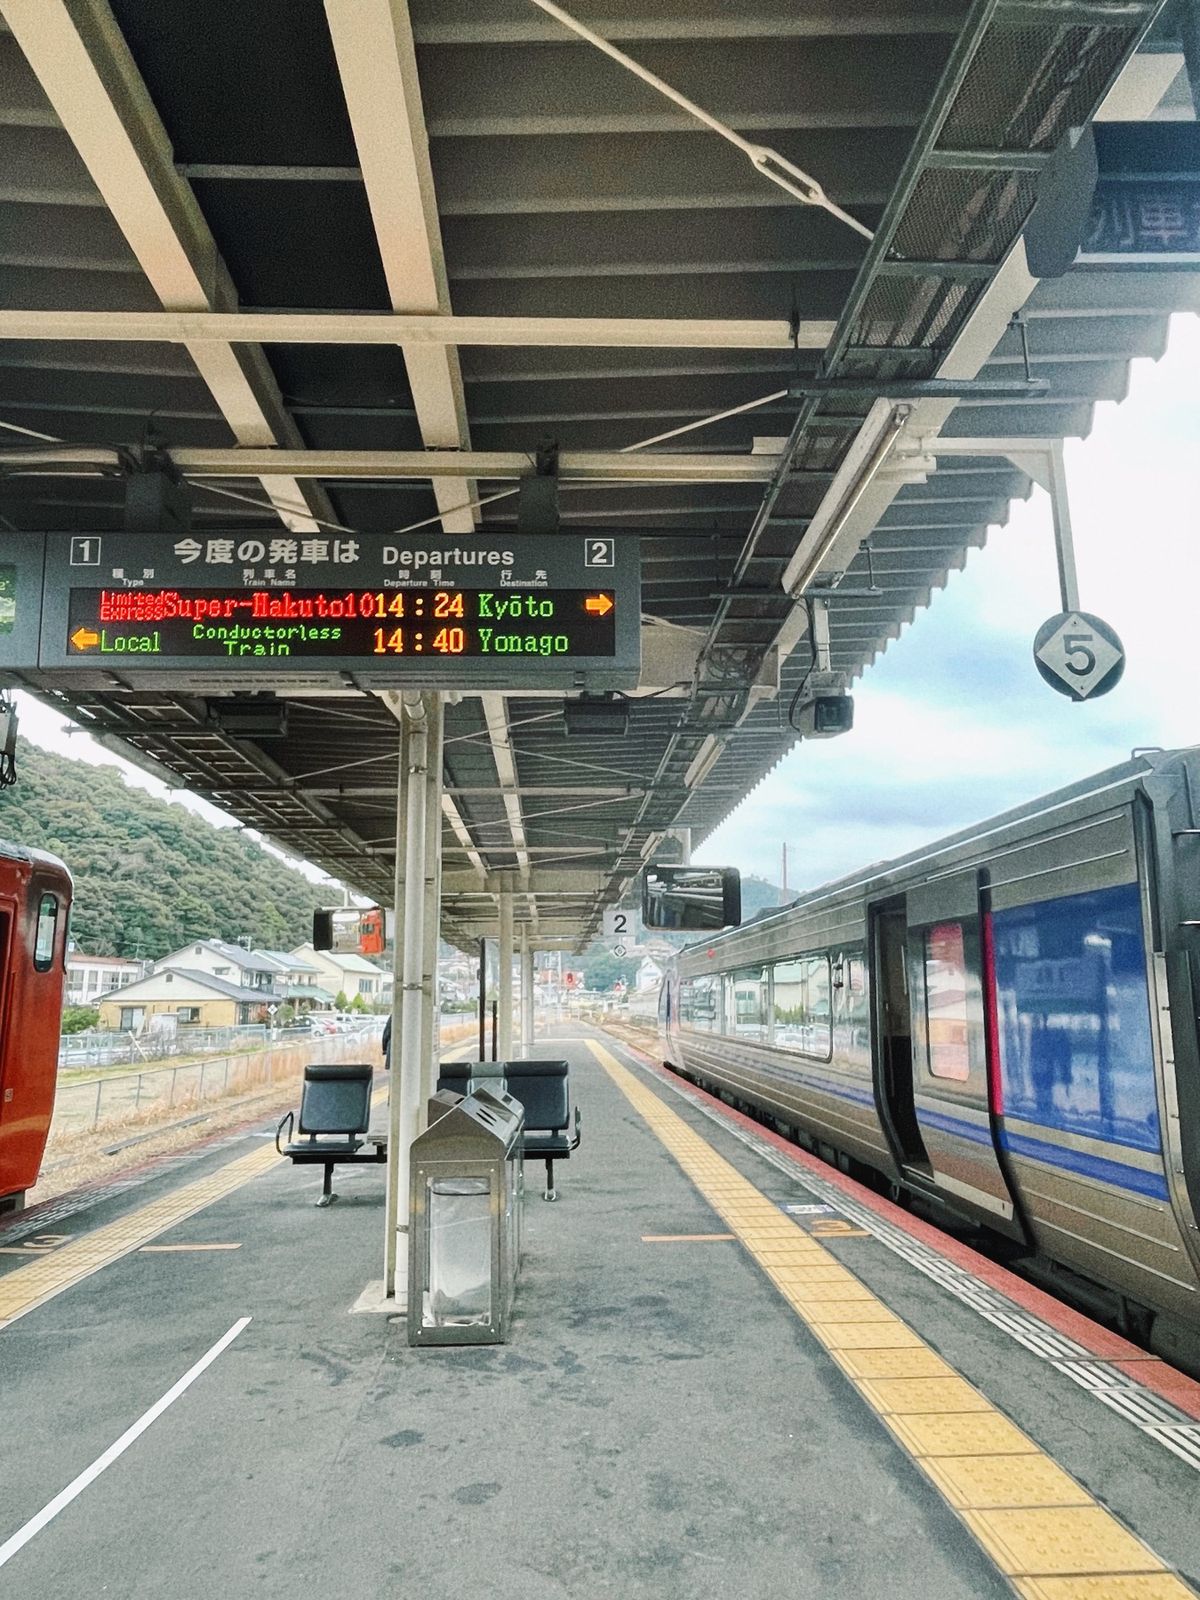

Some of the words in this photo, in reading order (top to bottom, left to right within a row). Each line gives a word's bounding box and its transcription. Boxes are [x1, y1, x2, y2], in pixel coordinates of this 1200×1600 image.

[79, 540, 91, 562] 1
[173, 538, 360, 565] 今度の発車は
[382, 547, 515, 569] Departures
[591, 542, 608, 564] 2
[121, 578, 144, 588] Type
[243, 578, 266, 586] Train
[270, 578, 297, 586] Name
[383, 579, 428, 588] Departure
[432, 579, 455, 587] Time
[500, 579, 548, 587] Destination
[101, 590, 164, 605] Limited
[374, 592, 465, 619] 14:24
[478, 594, 554, 620] Kyōto
[100, 605, 163, 621] Express
[100, 631, 161, 652] Local
[192, 624, 342, 640] Conductorless
[373, 627, 465, 654] 14:40
[478, 628, 569, 655] Yonago
[223, 640, 290, 656] Train
[1063, 634, 1096, 676] 5
[614, 914, 627, 933] 2
